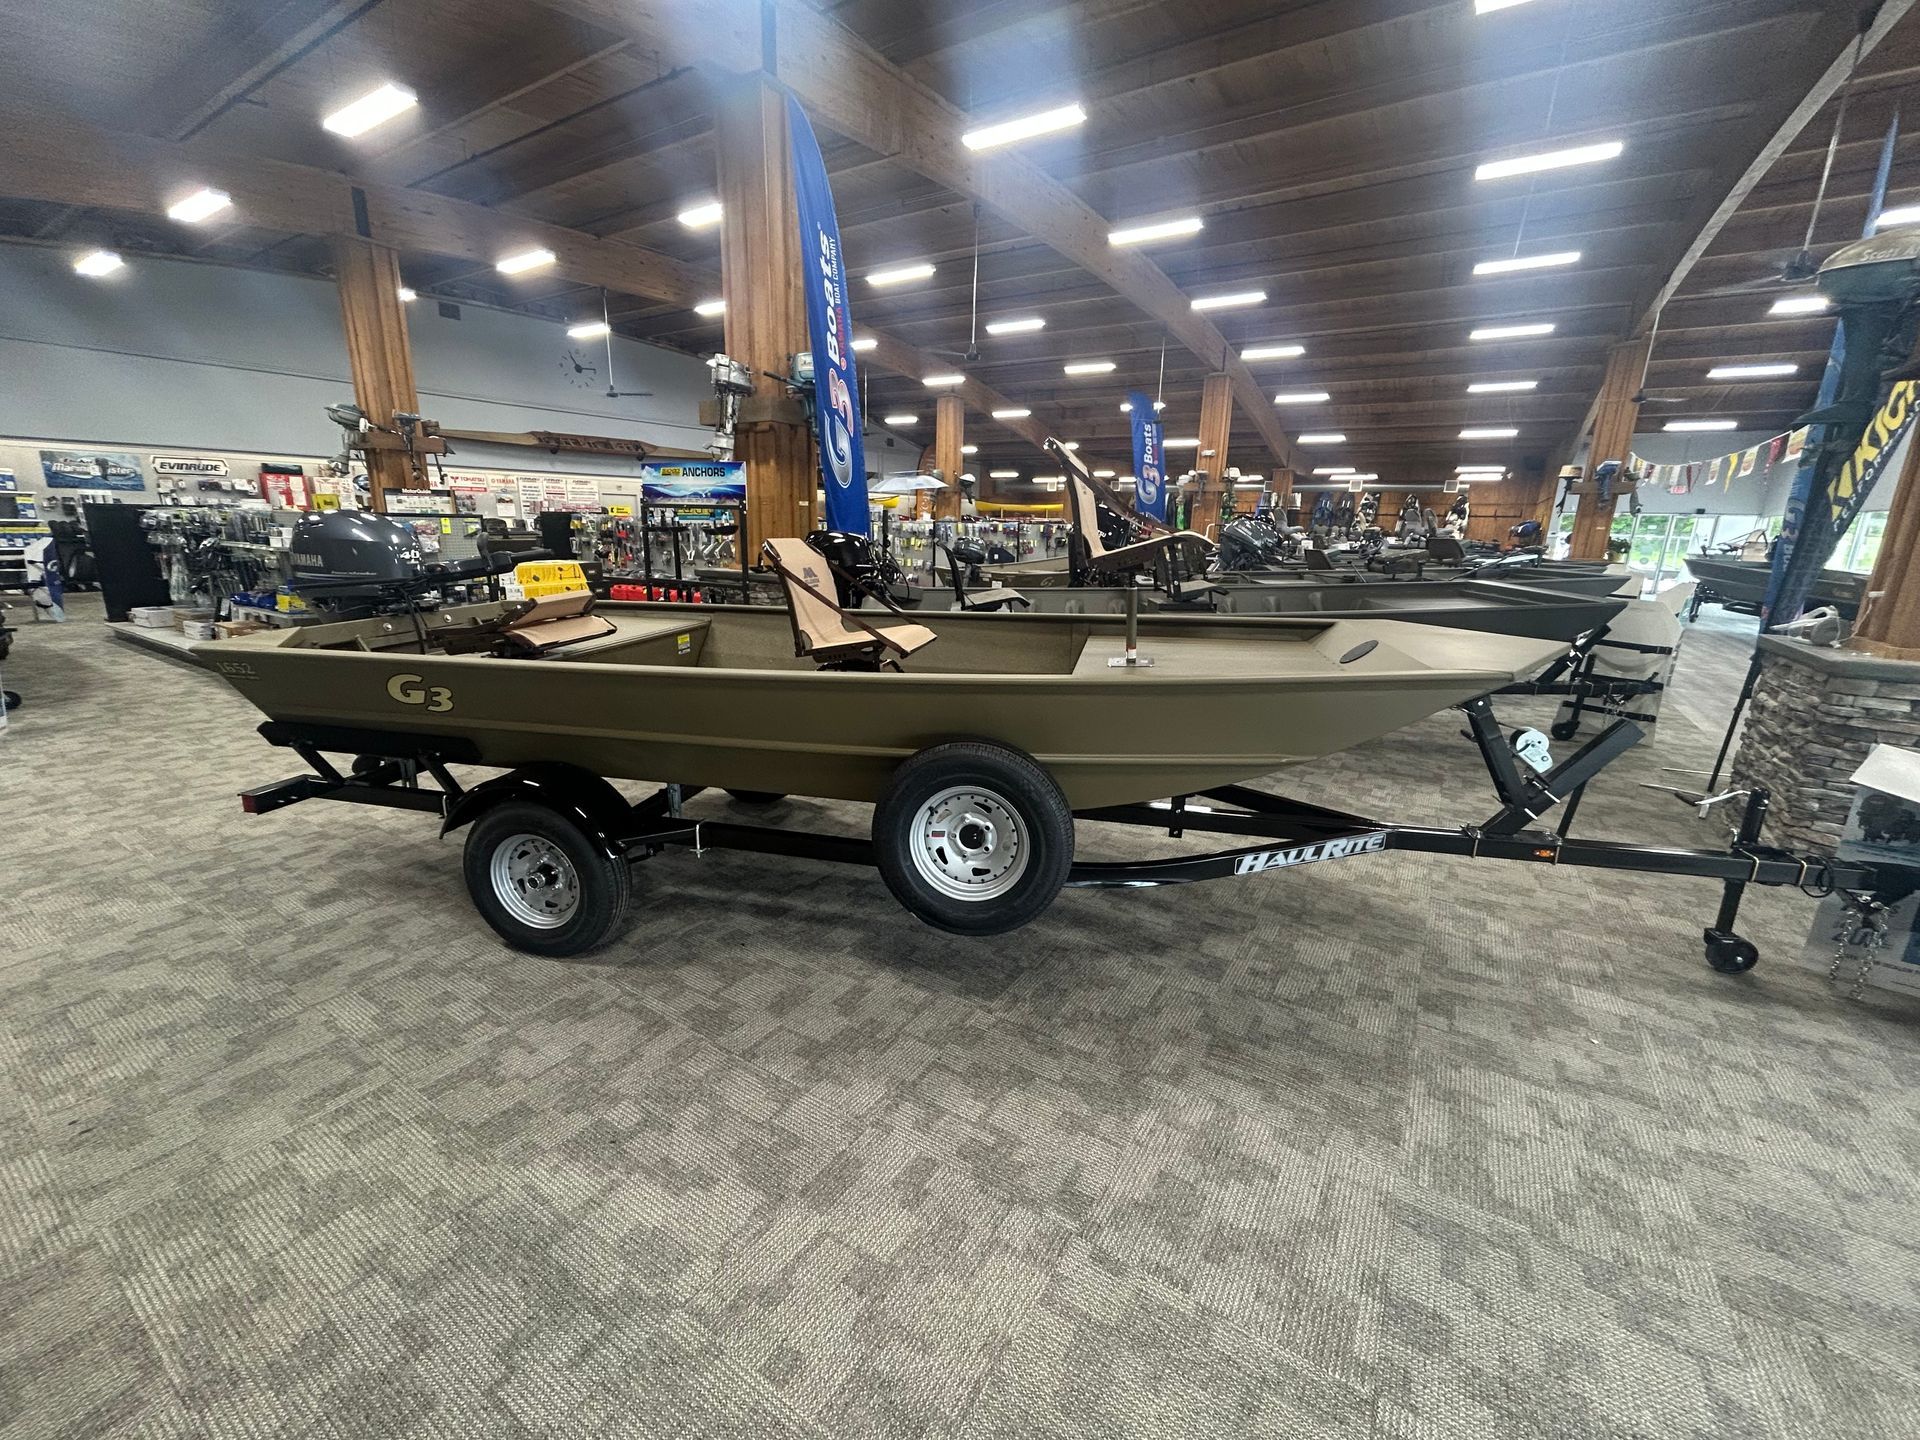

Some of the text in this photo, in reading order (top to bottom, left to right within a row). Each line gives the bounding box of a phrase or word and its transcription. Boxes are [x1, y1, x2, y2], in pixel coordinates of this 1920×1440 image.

[828, 237, 839, 279] COMPANY
[818, 230, 854, 489] G3 Boats
[1144, 423, 1153, 464] Boats
[159, 461, 221, 473] EVINRUDE
[682, 467, 726, 477] ANCHORS
[217, 662, 257, 675] 1652
[386, 673, 455, 713] G3
